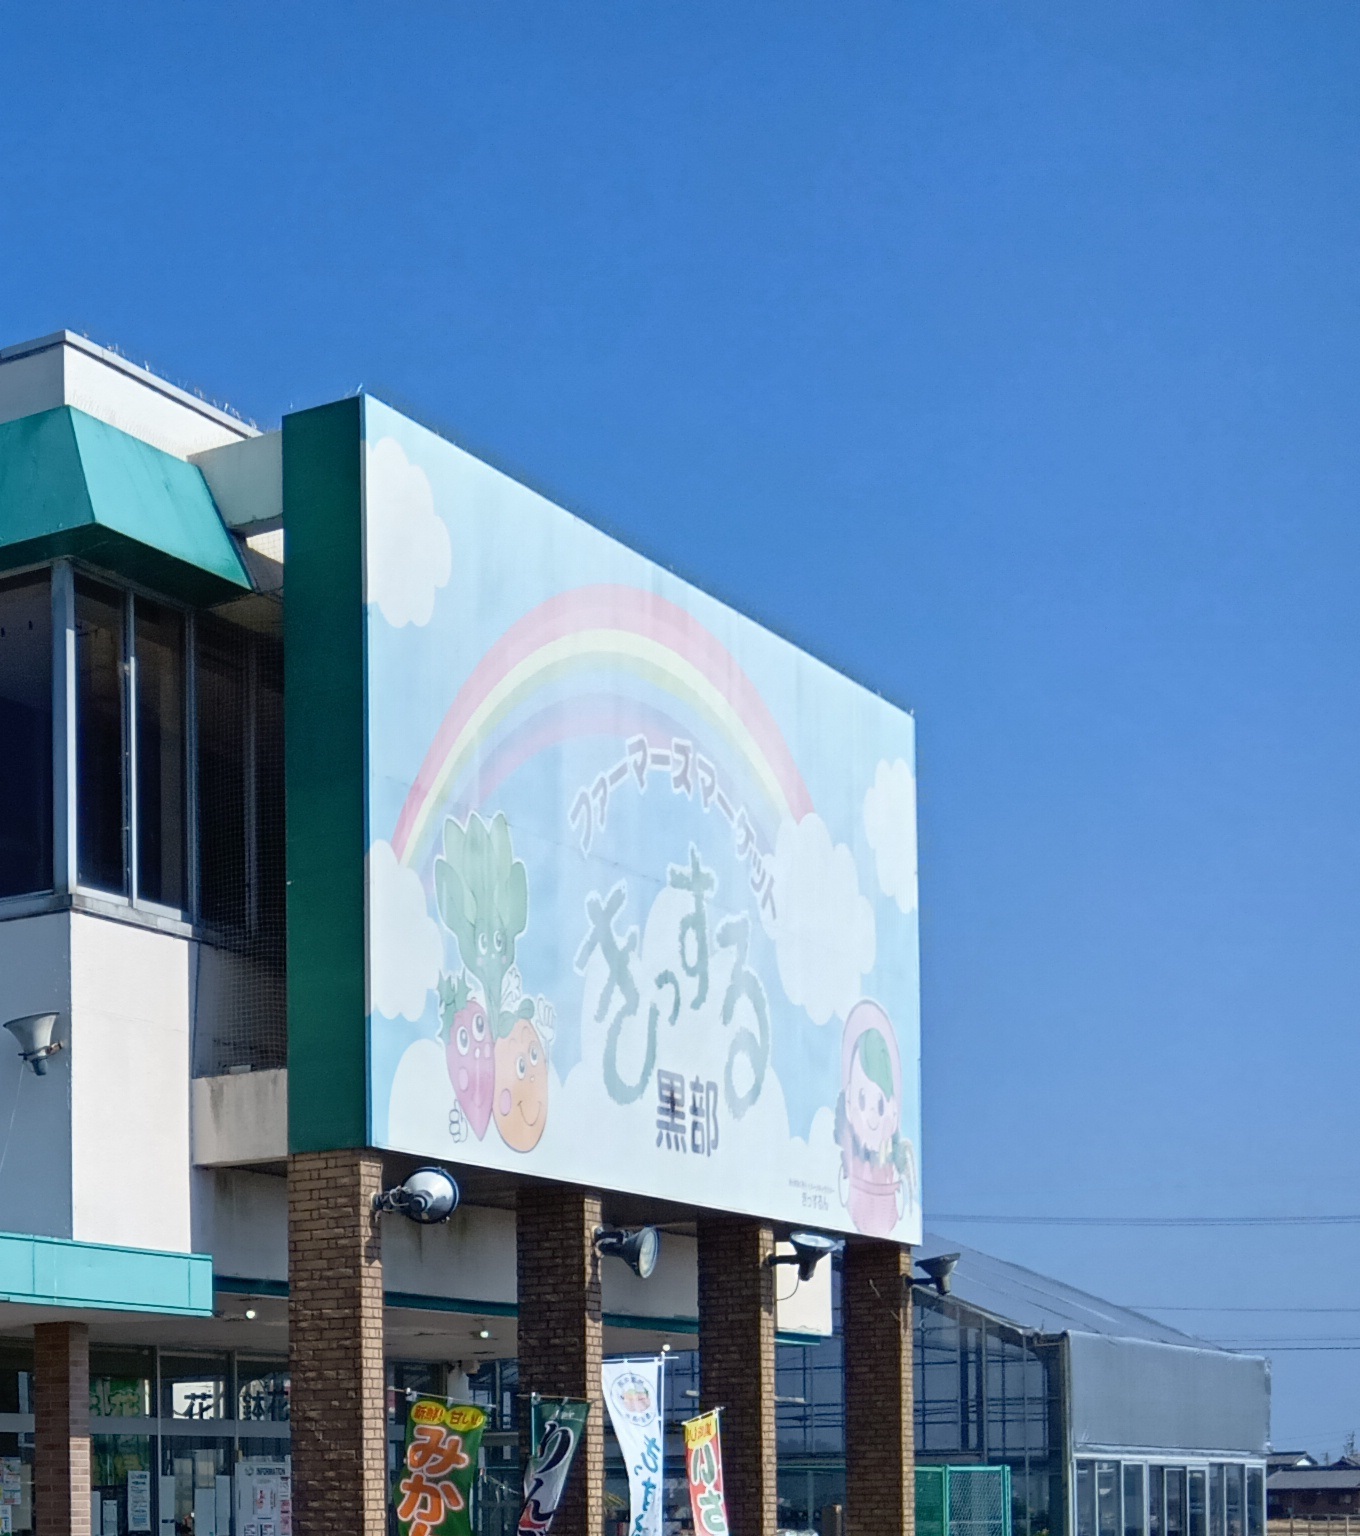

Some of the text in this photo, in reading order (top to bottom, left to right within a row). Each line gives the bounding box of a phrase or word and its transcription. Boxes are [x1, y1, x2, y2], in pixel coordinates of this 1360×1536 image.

[573, 841, 771, 1121] きっする
[655, 1068, 719, 1157] 黒部
